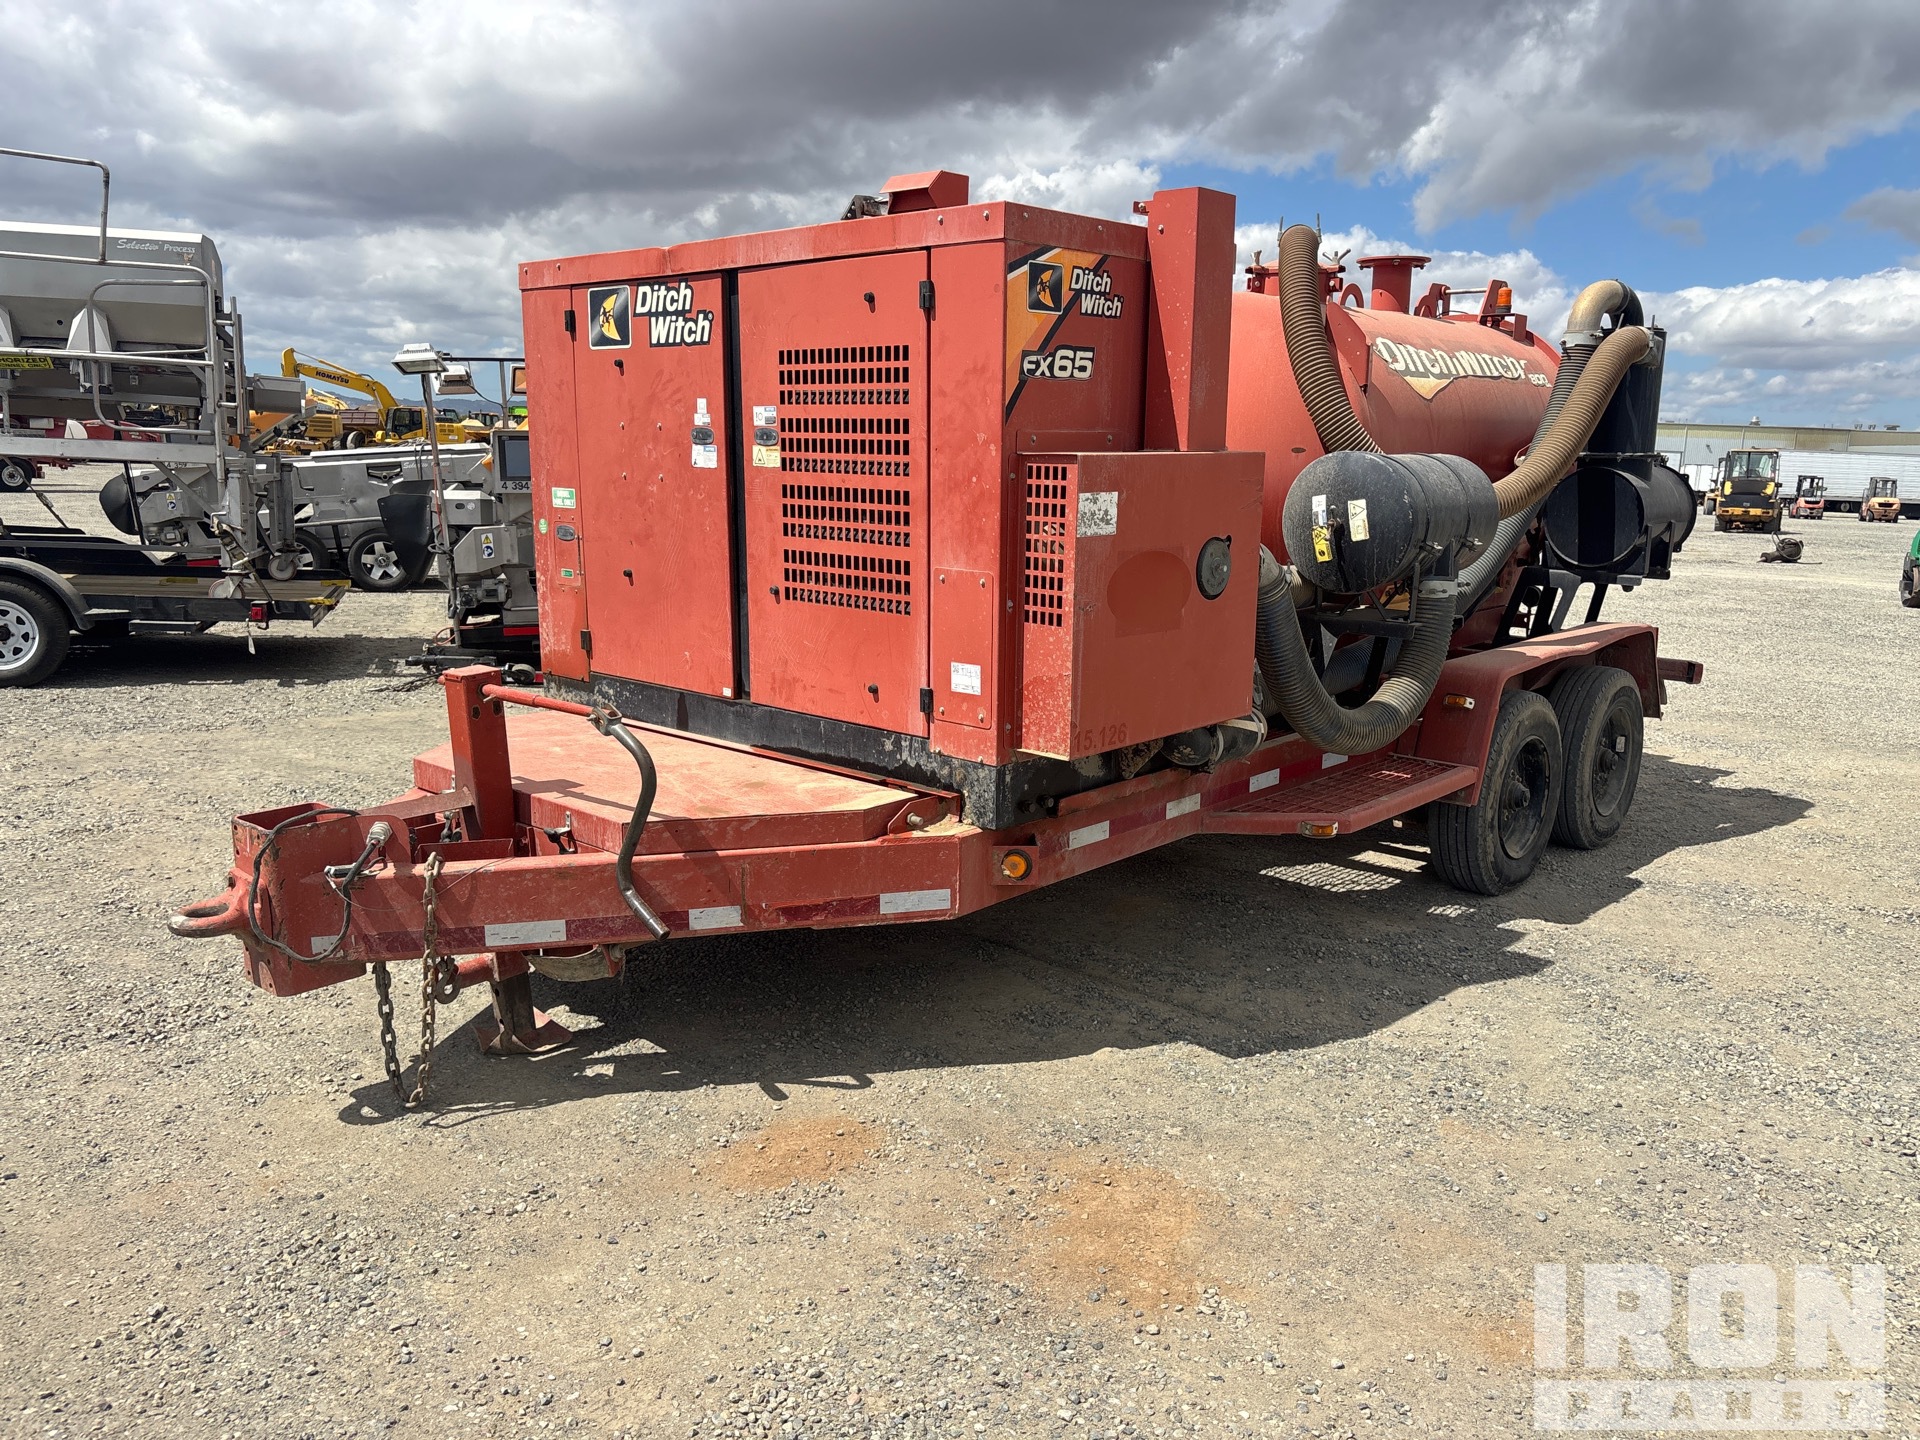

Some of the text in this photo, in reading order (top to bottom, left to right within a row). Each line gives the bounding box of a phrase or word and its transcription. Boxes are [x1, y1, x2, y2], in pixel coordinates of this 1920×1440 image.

[163, 243, 196, 254] Process
[1070, 268, 1111, 293] Ditch
[635, 282, 692, 314] Ditch
[315, 371, 350, 384] KOMATSU
[501, 481, 530, 490] 4 394
[1073, 722, 1127, 752] 15.126
